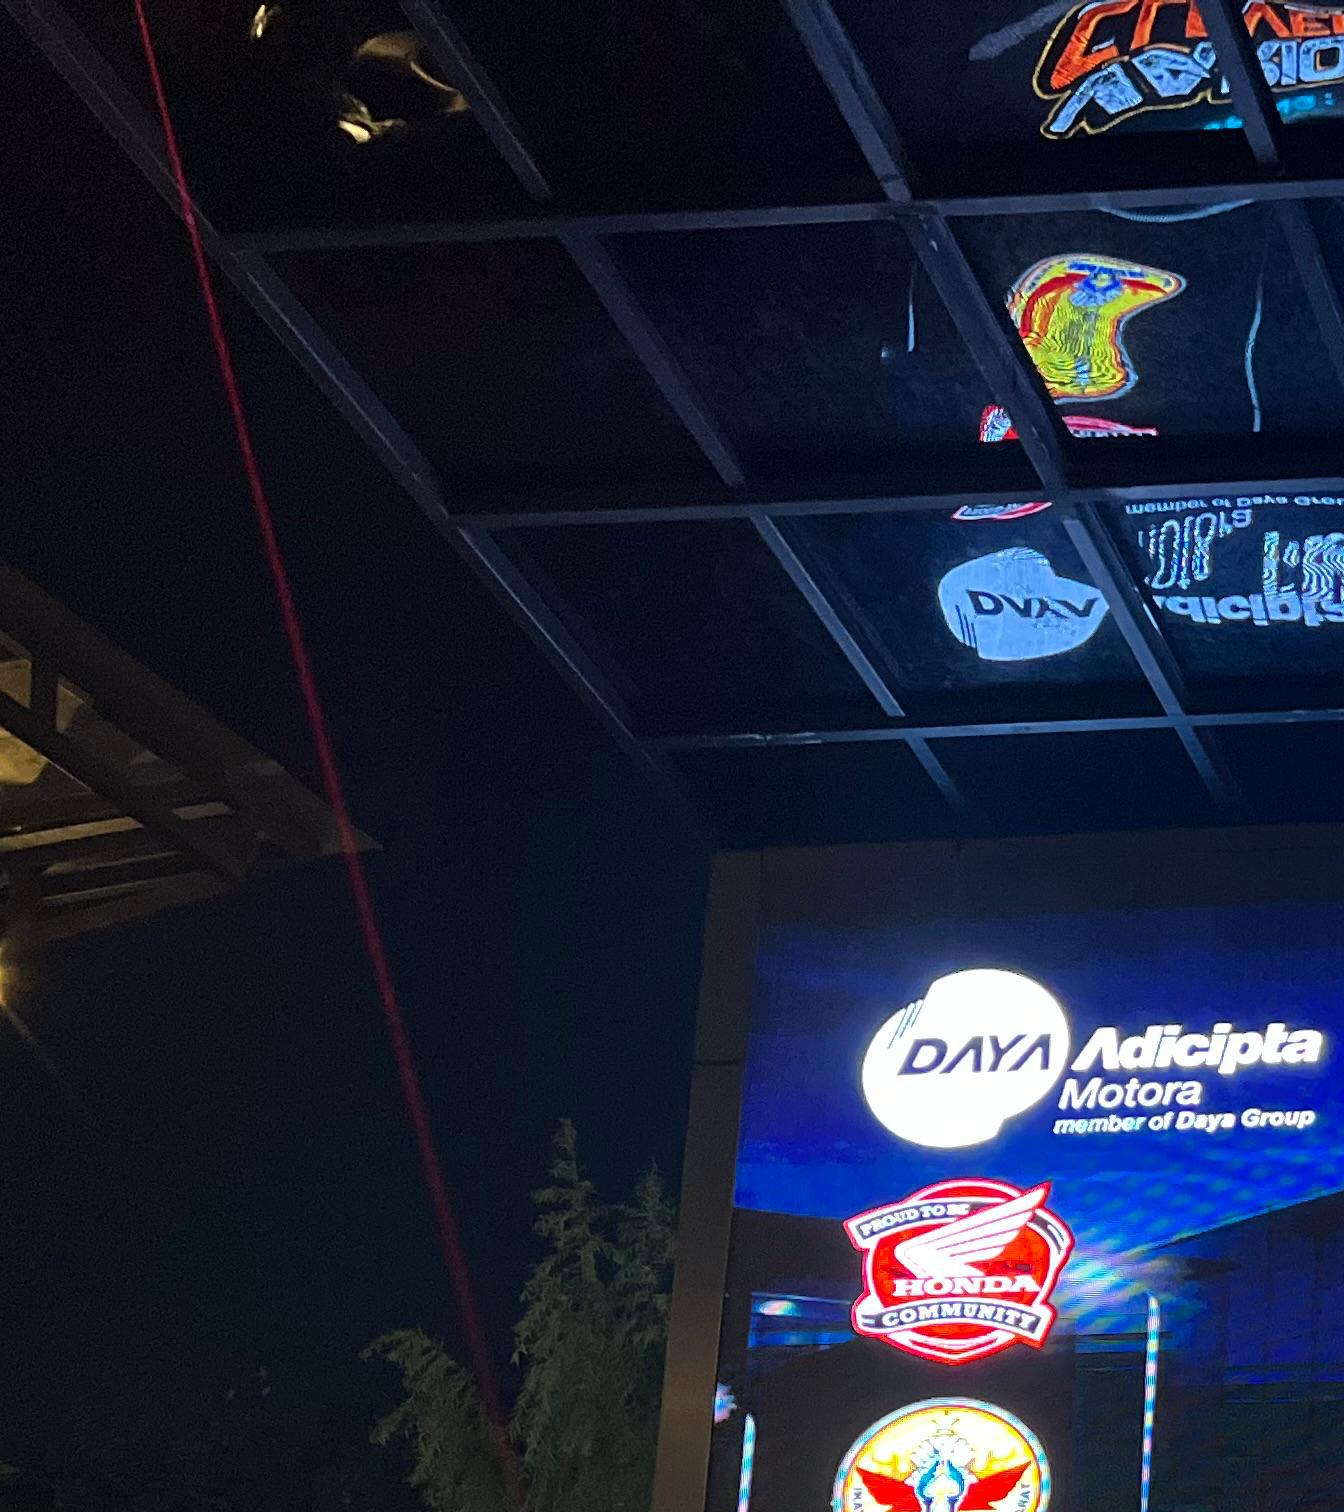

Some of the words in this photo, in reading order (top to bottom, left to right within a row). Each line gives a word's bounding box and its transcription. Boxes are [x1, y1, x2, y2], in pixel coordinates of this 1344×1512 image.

[897, 1033, 1052, 1077] DAYA
[1070, 1022, 1323, 1075] Adicipta
[1058, 1077, 1203, 1110] Motora
[1053, 1114, 1147, 1135] member
[1148, 1111, 1175, 1131] of
[1175, 1111, 1236, 1133] Daya
[1240, 1108, 1316, 1129] Group
[860, 1208, 921, 1238] PROUD
[921, 1204, 948, 1219] TO
[892, 1275, 1043, 1297] HONDA
[881, 1301, 1038, 1330] COMMUNITY
